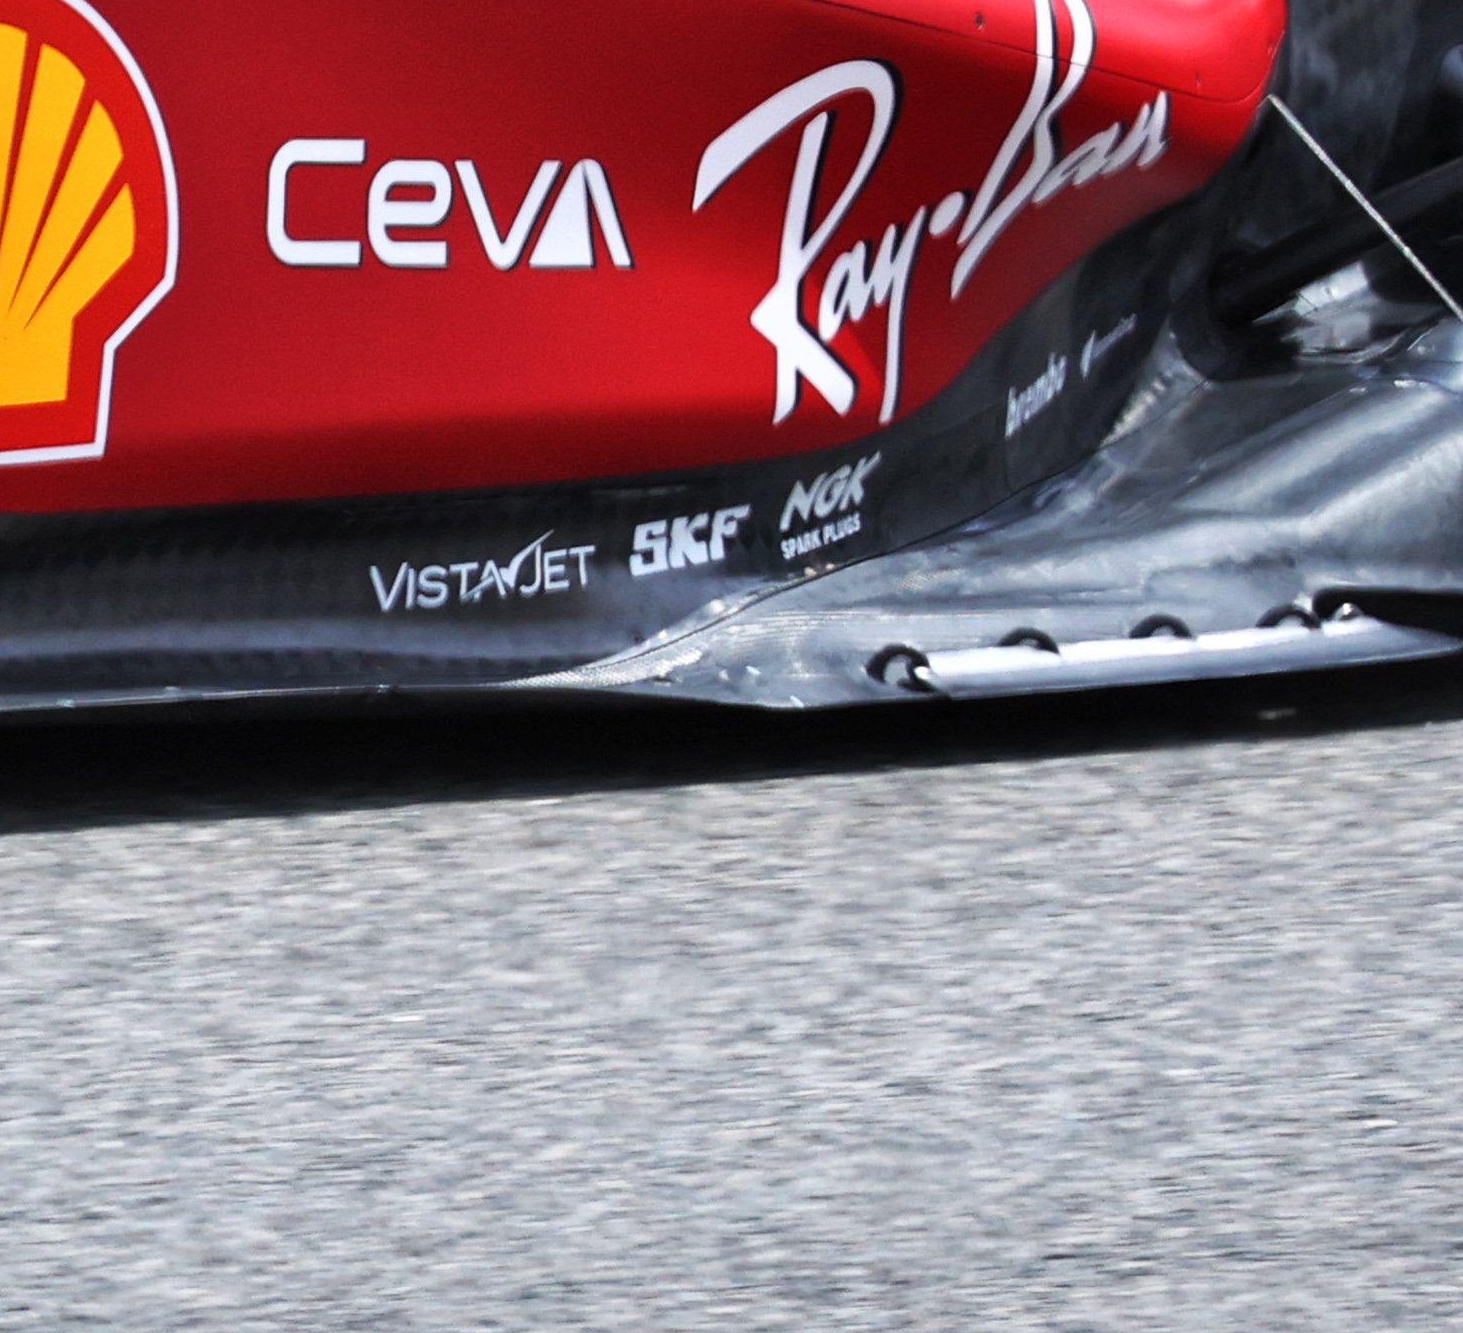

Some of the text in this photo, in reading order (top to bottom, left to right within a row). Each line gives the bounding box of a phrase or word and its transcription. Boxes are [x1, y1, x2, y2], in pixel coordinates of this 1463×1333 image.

[779, 450, 882, 532] NGK
[630, 506, 751, 577] SKF
[780, 511, 861, 560] SPARK PLUGS
